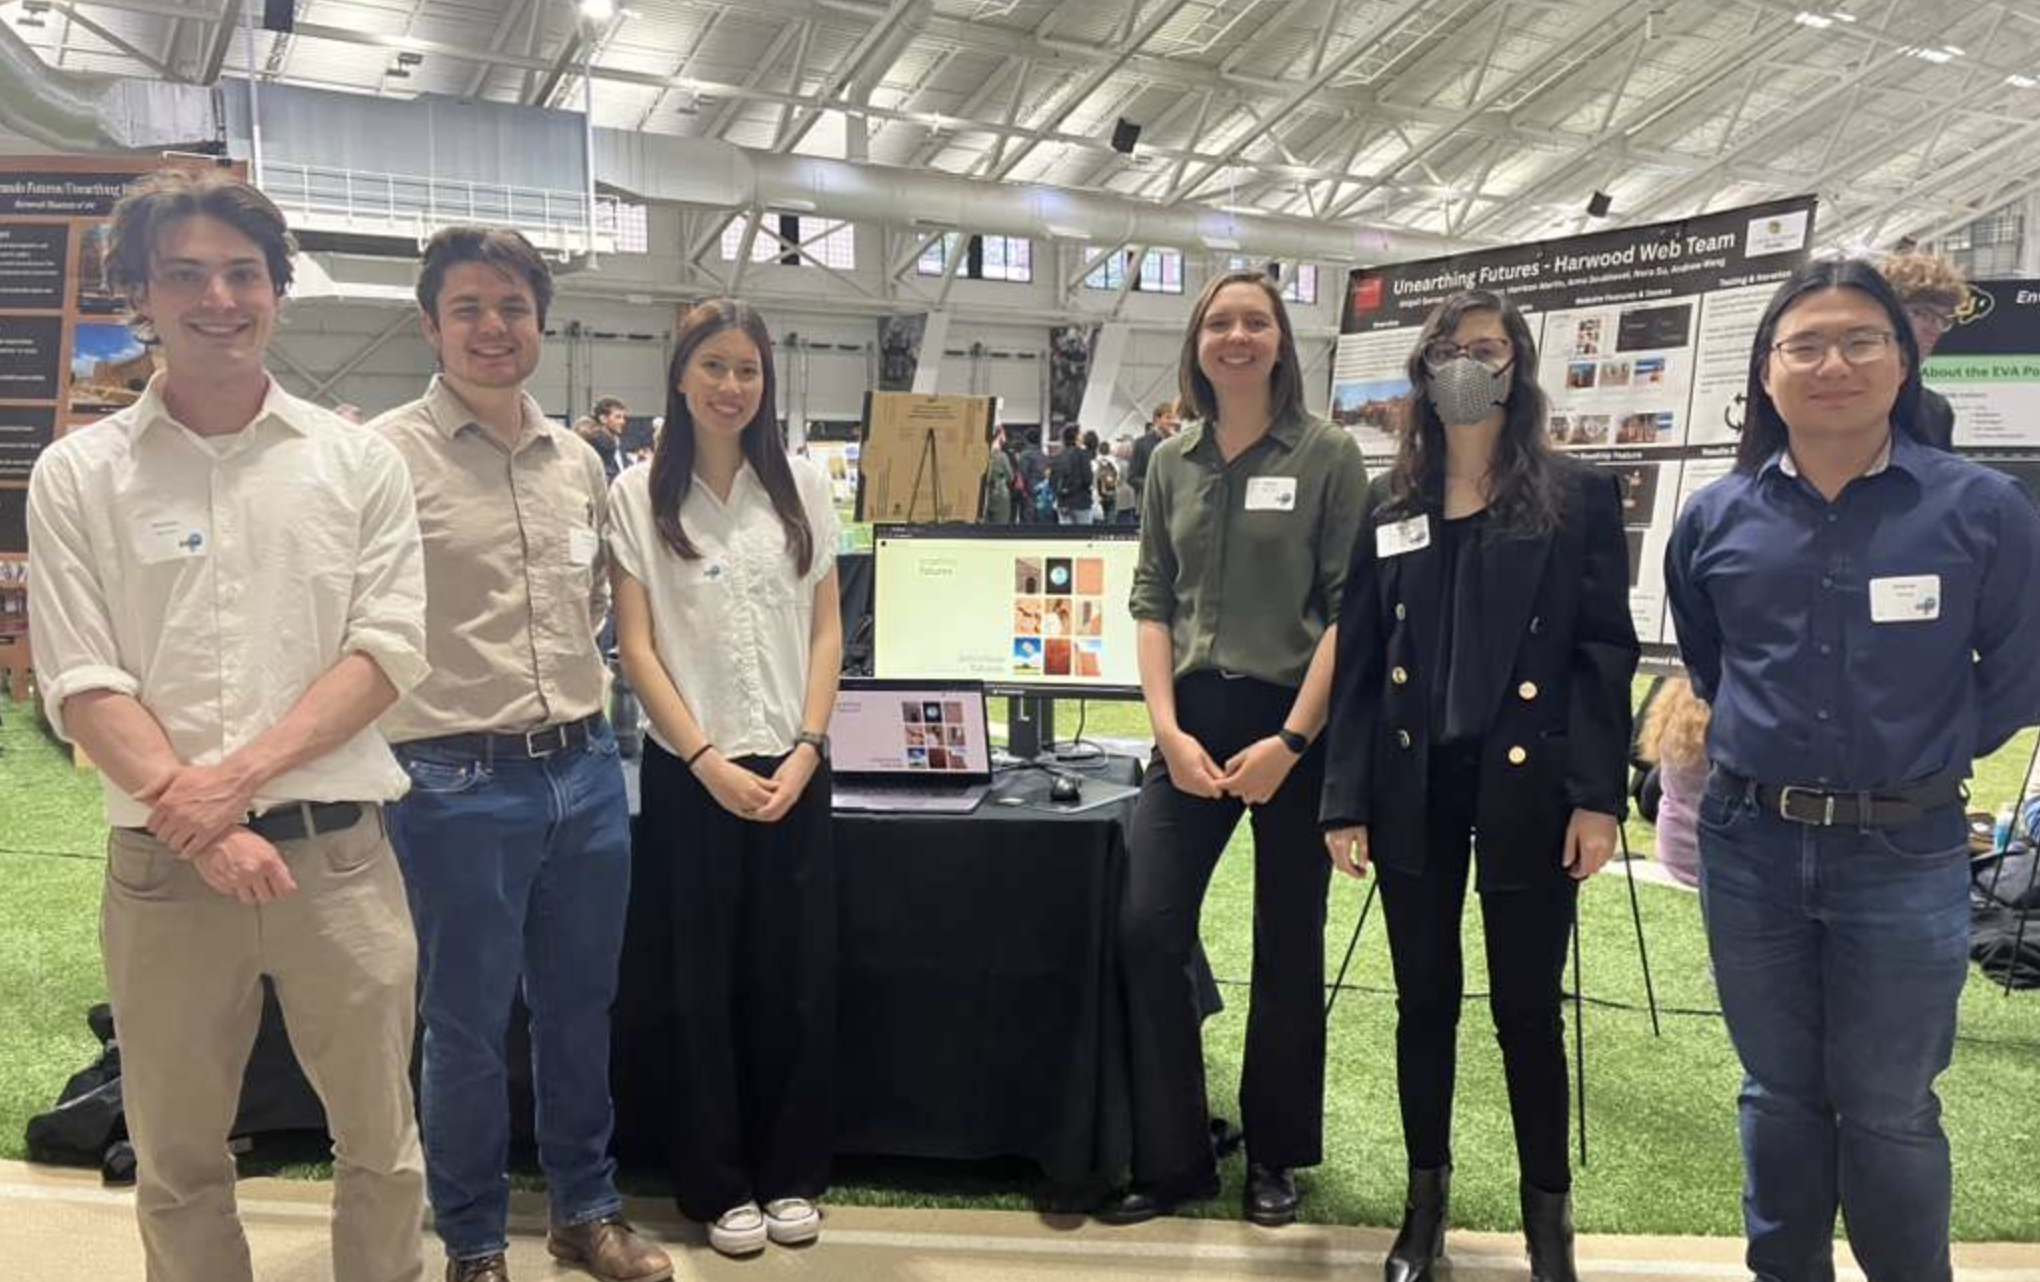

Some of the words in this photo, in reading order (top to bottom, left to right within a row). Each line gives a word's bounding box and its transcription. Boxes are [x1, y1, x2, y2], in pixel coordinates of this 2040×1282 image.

[1393, 271, 1476, 295] Unearthing
[1479, 262, 1540, 284] Futures
[1554, 245, 1635, 274] Harwood
[1639, 235, 1682, 262] Web
[1686, 231, 1736, 257] Team
[1922, 365, 1962, 379] About
[1965, 365, 1988, 378] the
[1992, 366, 2020, 378] EVA
